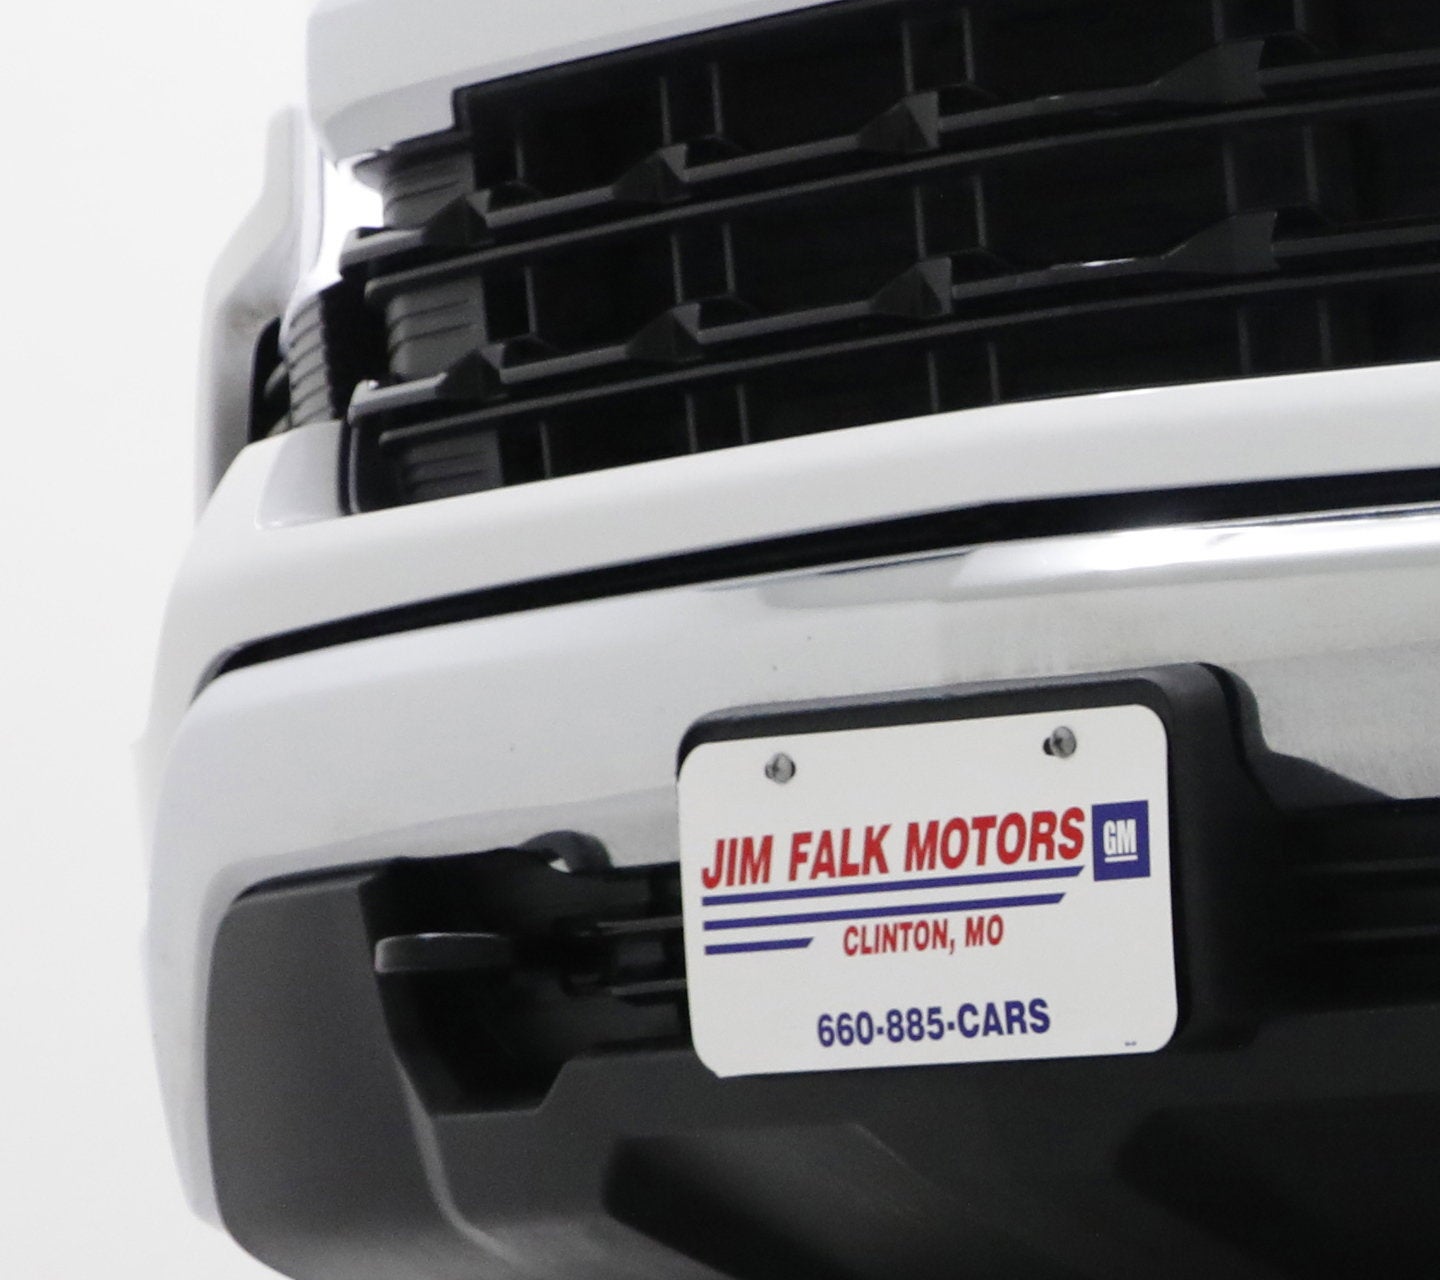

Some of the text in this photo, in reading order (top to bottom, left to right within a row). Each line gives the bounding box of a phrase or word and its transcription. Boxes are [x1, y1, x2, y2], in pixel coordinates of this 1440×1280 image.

[701, 807, 1085, 889] JIM FALK MOTORS
[1102, 818, 1138, 856] GM
[843, 915, 1004, 956] CLINTON, MO
[817, 997, 1051, 1047] 660-885-CARS
